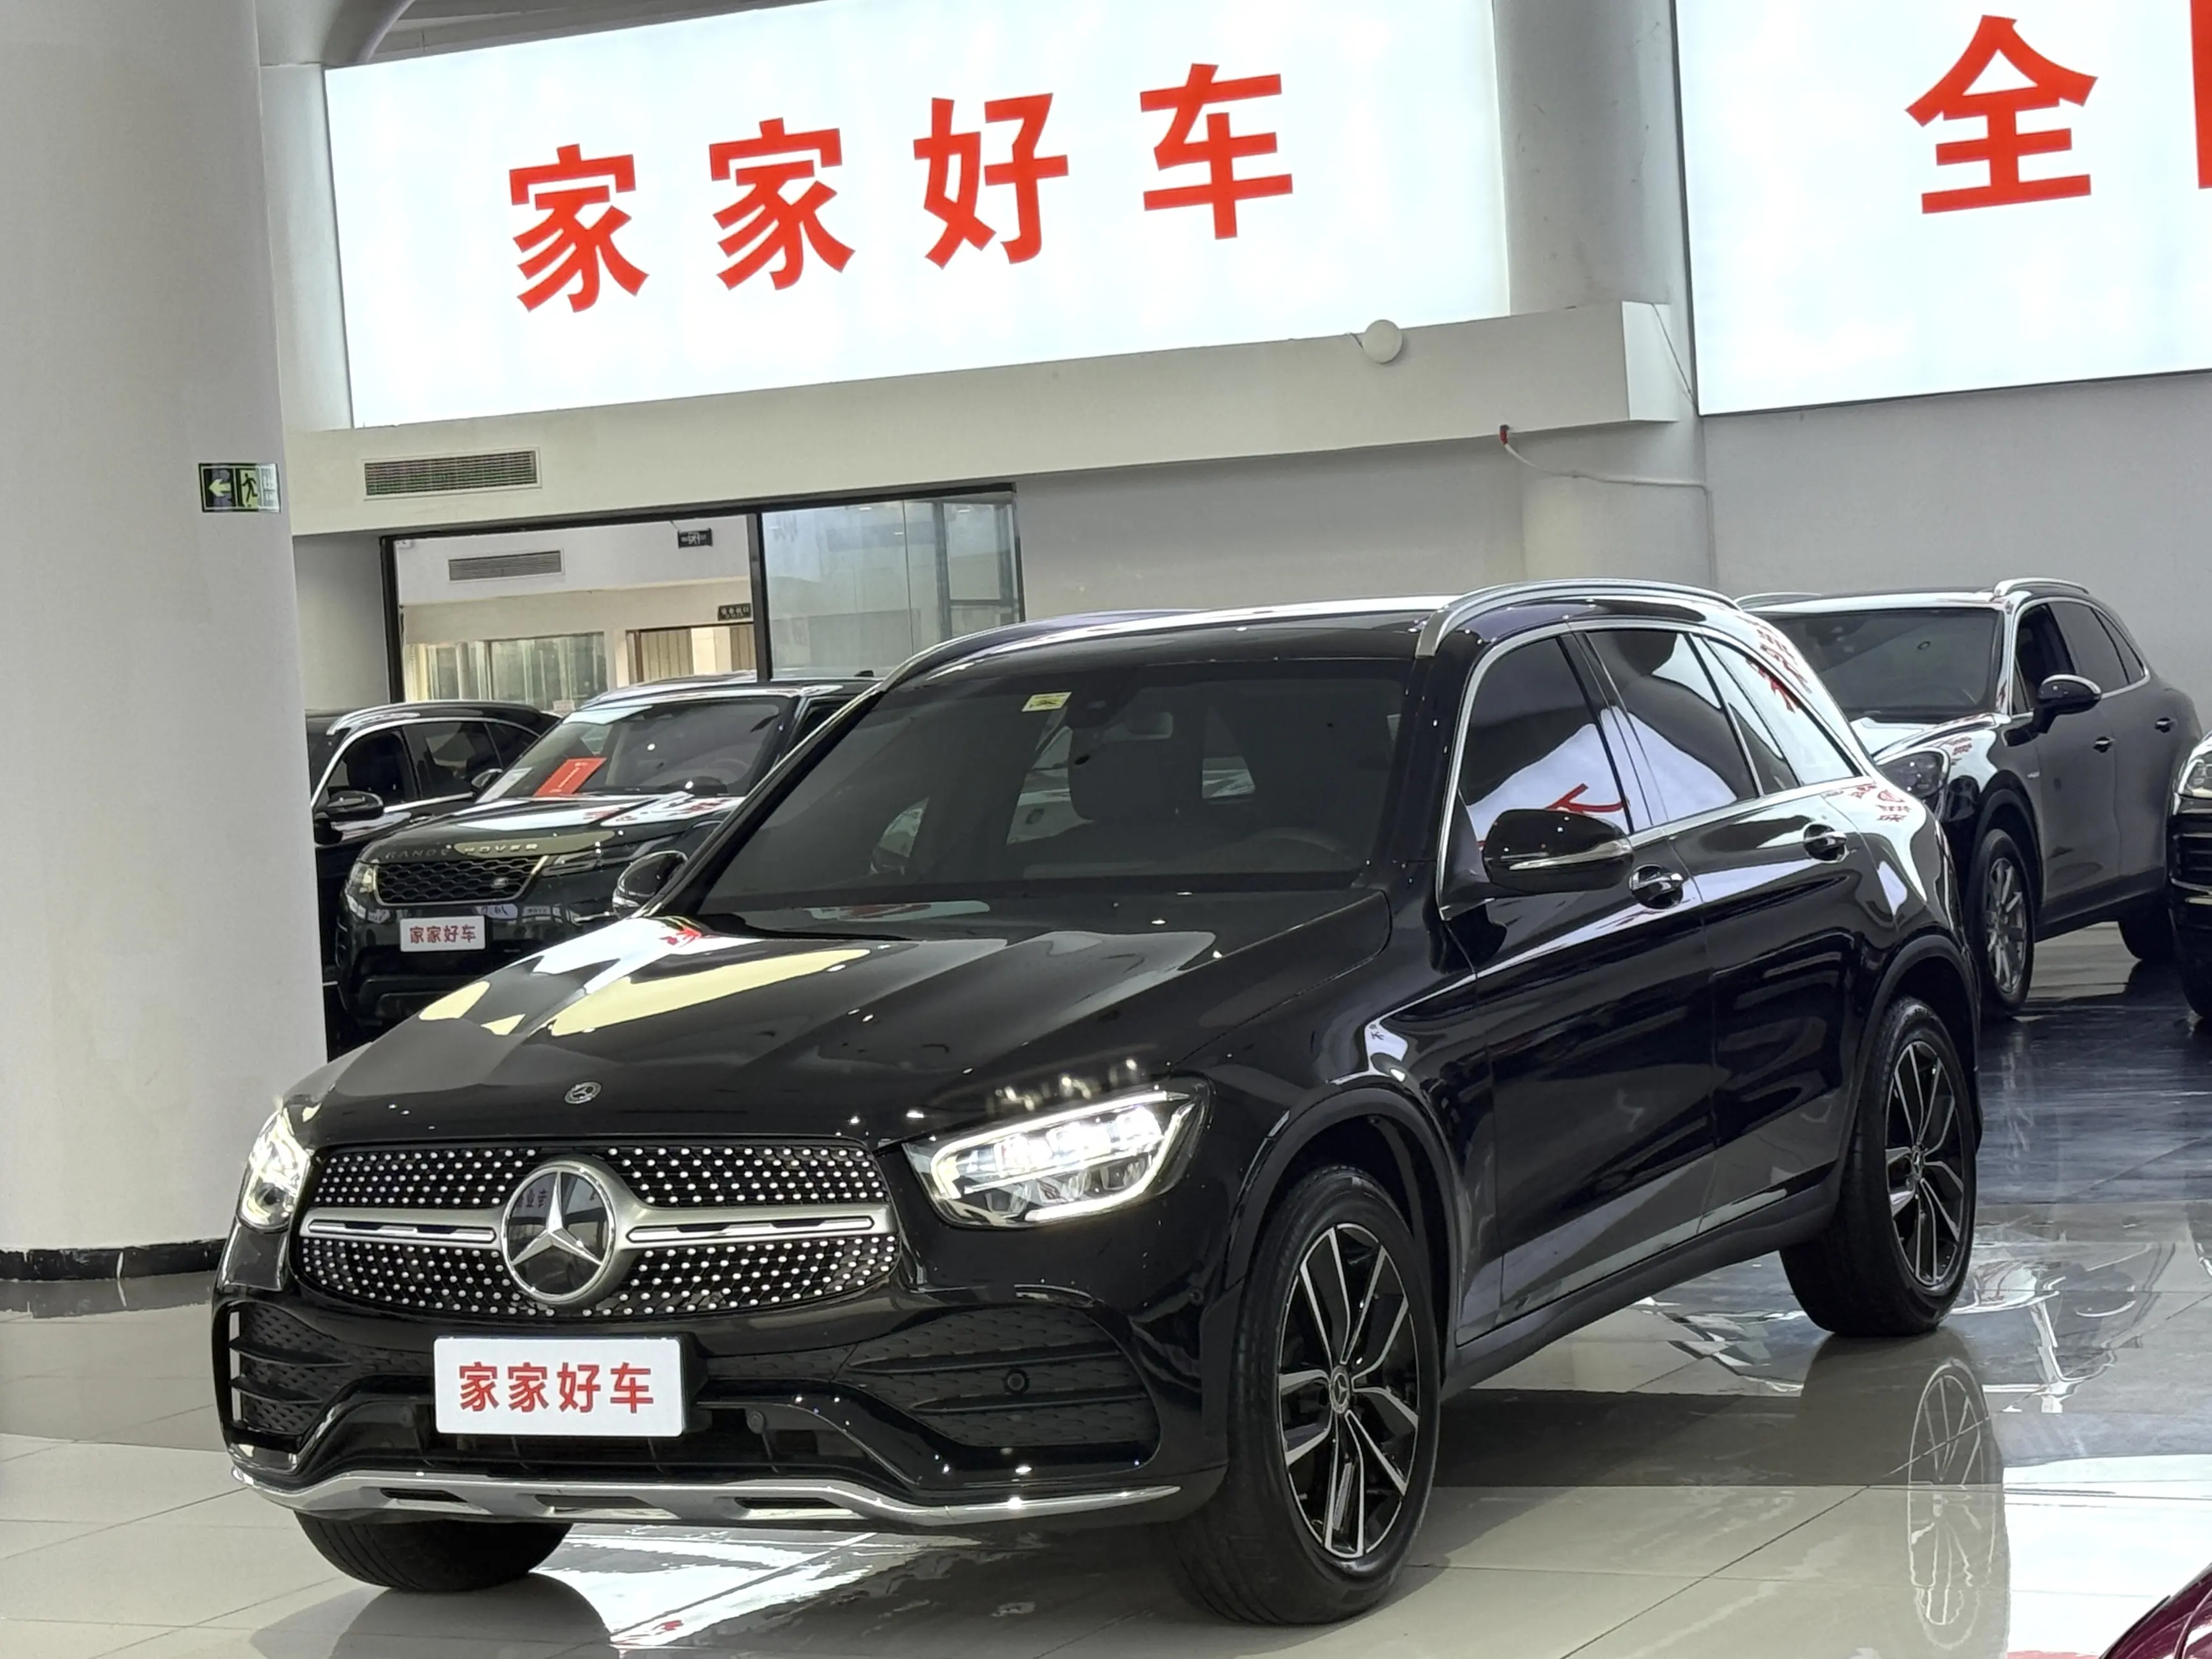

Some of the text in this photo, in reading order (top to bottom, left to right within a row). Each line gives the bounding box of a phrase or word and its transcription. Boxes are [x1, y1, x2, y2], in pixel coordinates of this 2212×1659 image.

[1908, 0, 2212, 212] 全
[510, 64, 1292, 310] 家家好车
[410, 924, 477, 943] 家家好车
[458, 1361, 654, 1413] 家家好车
